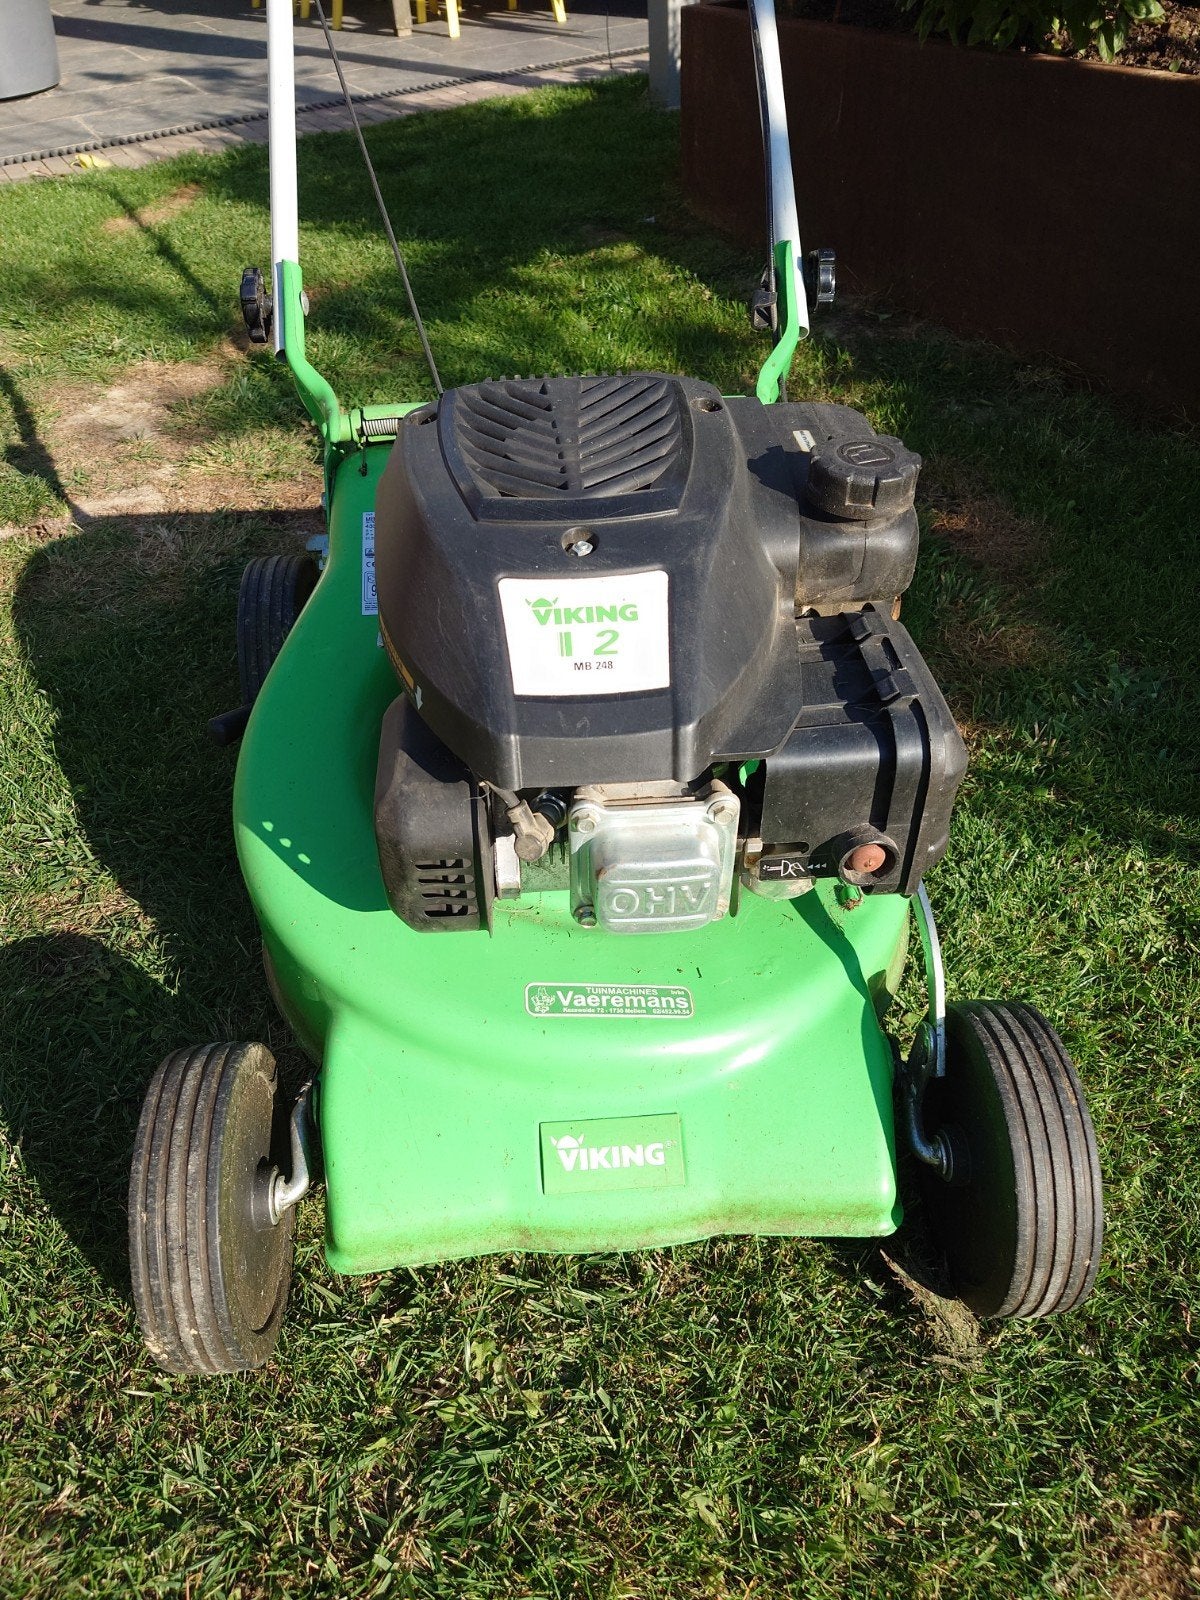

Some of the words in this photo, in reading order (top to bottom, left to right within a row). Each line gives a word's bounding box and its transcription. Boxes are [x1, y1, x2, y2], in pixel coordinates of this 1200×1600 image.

[532, 603, 639, 626] VIKING
[593, 629, 620, 656] 2
[573, 661, 592, 671] MB
[595, 660, 614, 670] 248
[604, 881, 712, 916] OHV
[556, 990, 690, 1009] Vaeremans
[585, 986, 659, 996] TUINMACHINES
[557, 1142, 666, 1172] VIKING
